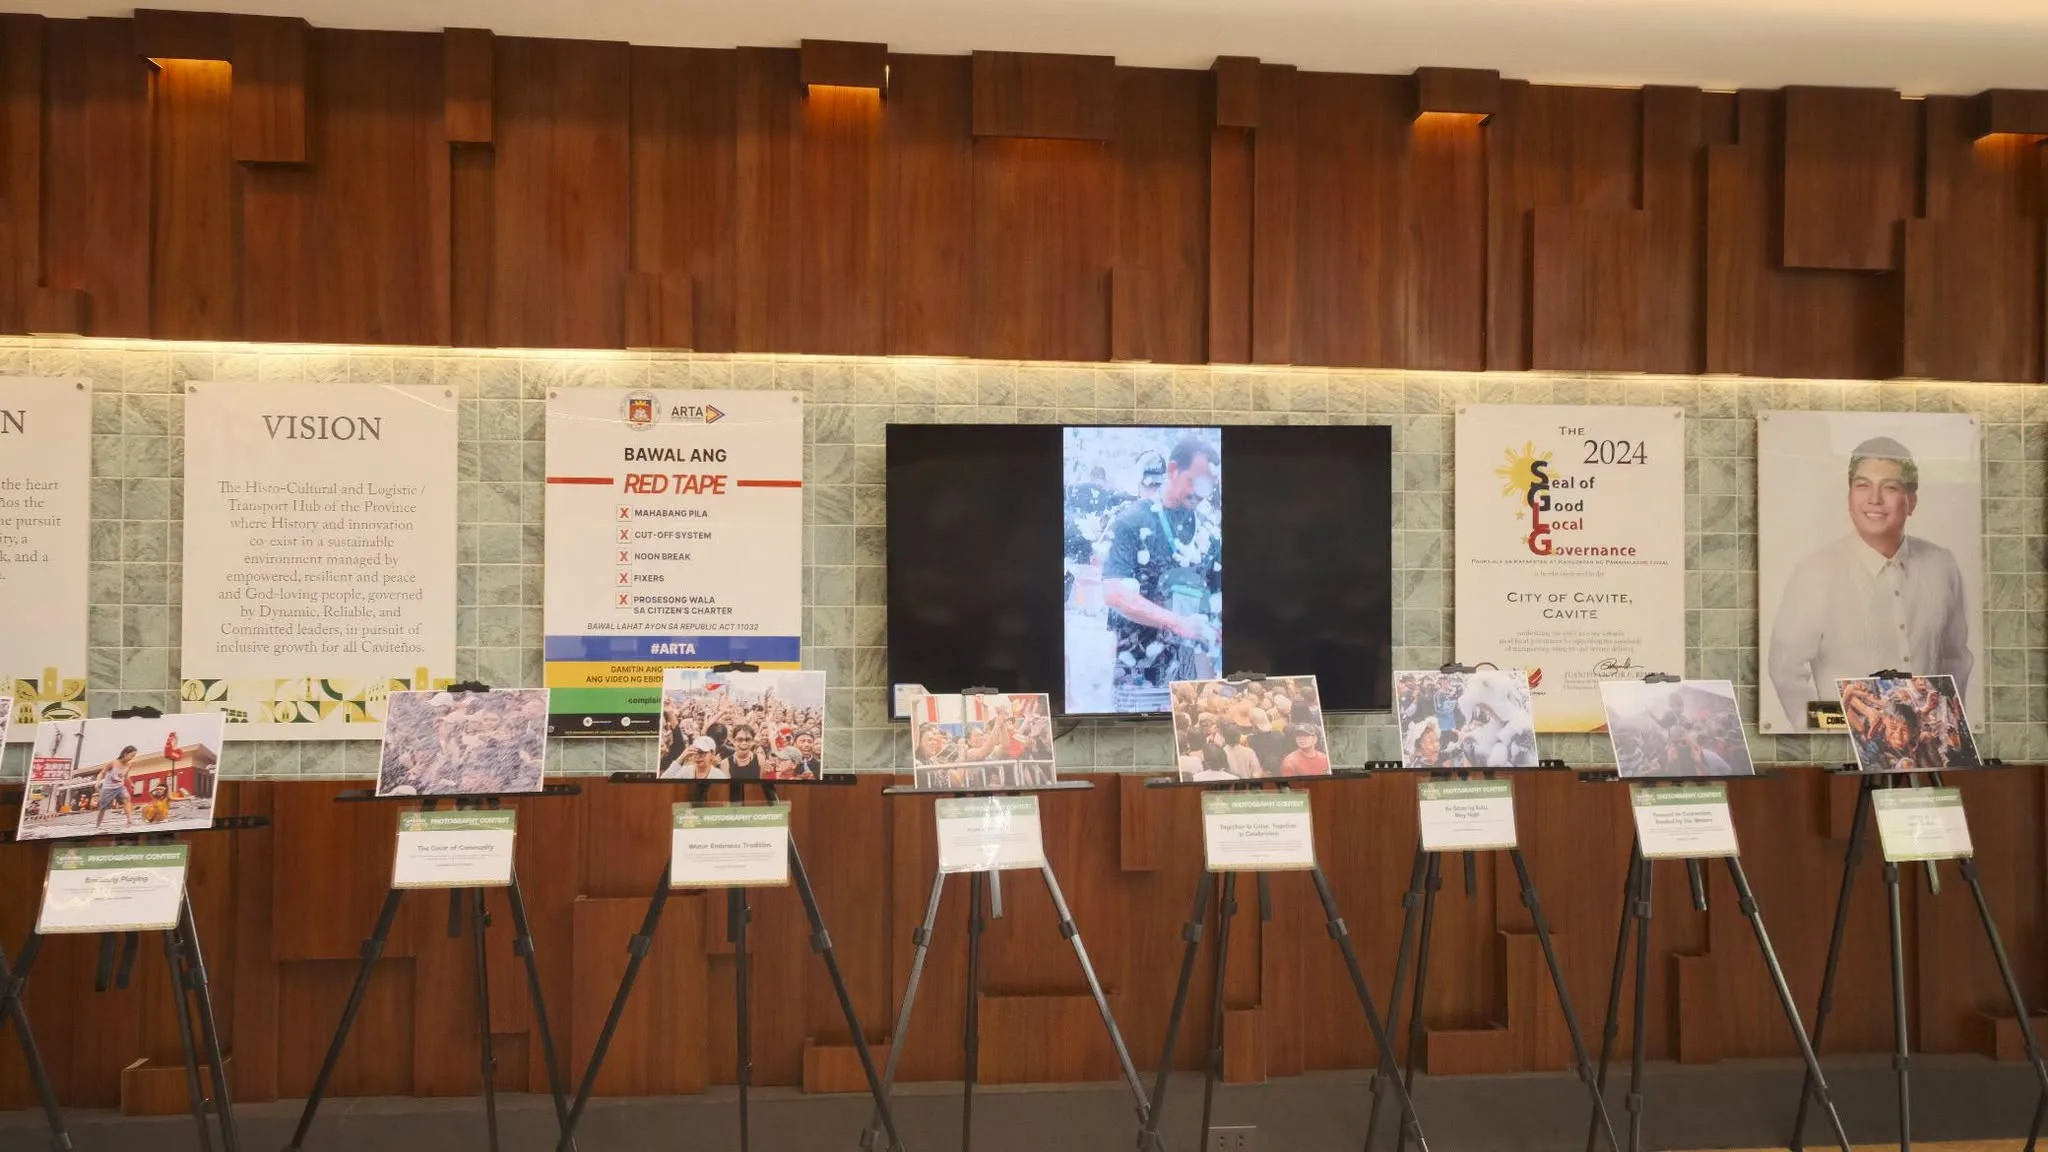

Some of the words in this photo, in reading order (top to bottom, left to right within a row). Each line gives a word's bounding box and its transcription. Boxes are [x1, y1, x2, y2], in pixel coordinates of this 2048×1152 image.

[671, 406, 704, 417] ARTA
[0, 410, 26, 434] N
[263, 415, 382, 441] VISION
[1558, 426, 1585, 436] THE
[624, 447, 686, 462] BAWAL
[690, 448, 727, 463] ANG
[1583, 440, 1648, 465] 2024
[1, 478, 21, 491] the
[26, 478, 59, 491] heart
[624, 473, 668, 494] RED
[672, 475, 728, 495] TAPE
[1580, 476, 1596, 489] of
[217, 480, 241, 493] The
[245, 481, 337, 494] Histo-Cultural
[341, 483, 364, 495] and
[368, 483, 417, 499] Logistic
[420, 485, 426, 497] /
[24, 496, 45, 508] the
[228, 499, 289, 514] Transport
[293, 500, 321, 512] Hub
[324, 500, 338, 512] of
[341, 500, 360, 512] the
[364, 500, 417, 513] Province
[634, 509, 687, 518] MAHABANG
[688, 509, 708, 518] PILA
[16, 515, 62, 530] pursuit
[230, 517, 267, 529] where
[272, 517, 318, 532] History
[322, 518, 345, 530] and
[348, 518, 414, 531] innovation
[21, 537, 28, 545] a
[249, 536, 298, 547] co-exist
[301, 536, 313, 547] in
[317, 538, 325, 547] a
[328, 536, 395, 548] sustainable
[634, 531, 674, 540] CUT-OFF
[675, 531, 712, 540] SYSTEM
[15, 549, 38, 563] and
[42, 553, 49, 562] a
[244, 553, 323, 565] environment
[327, 553, 381, 569] managed
[385, 553, 399, 568] by
[634, 552, 661, 561] NOON
[661, 552, 691, 561] BREAK
[226, 569, 302, 585] empowered,
[304, 570, 353, 582] resilient
[356, 571, 379, 583] and
[383, 574, 416, 586] peace
[633, 574, 665, 583] FIXERS
[218, 588, 241, 600] and
[245, 588, 318, 603] God-loving
[321, 588, 366, 604] people,
[367, 588, 423, 604] governed
[633, 596, 688, 605] PROSESONG
[689, 596, 716, 605] WALA
[1506, 592, 1542, 603] CITY
[1548, 594, 1568, 603] OF
[1573, 592, 1633, 605] CAVITE,
[240, 605, 255, 620] by
[259, 605, 320, 620] Dynamic,
[323, 605, 376, 618] Reliable,
[379, 606, 401, 618] and
[633, 606, 646, 615] SA
[647, 606, 690, 615] CITIZEN'S
[691, 606, 733, 615] CHARTER
[1543, 608, 1599, 620] CAVITE
[220, 623, 293, 636] Committed
[297, 623, 343, 637] leaders,
[346, 624, 358, 636] in
[361, 624, 404, 639] pursuit
[408, 622, 423, 636] of
[587, 623, 616, 631] BAWAL
[616, 623, 644, 631] LAHAT
[645, 623, 668, 631] AYON
[668, 623, 679, 631] SA
[680, 623, 718, 631] REPUBLIC
[719, 623, 736, 631] ACT
[736, 623, 759, 631] 11032
[216, 641, 270, 654] inclusive
[274, 641, 318, 657] growth
[321, 641, 340, 653] for
[343, 641, 357, 653] all
[361, 641, 425, 654] Caviteños.
[650, 643, 696, 656] #ARTA
[611, 665, 644, 673] GAMITIN
[586, 675, 603, 684] ANG
[605, 675, 629, 684] VIDEO
[631, 675, 642, 684] NG
